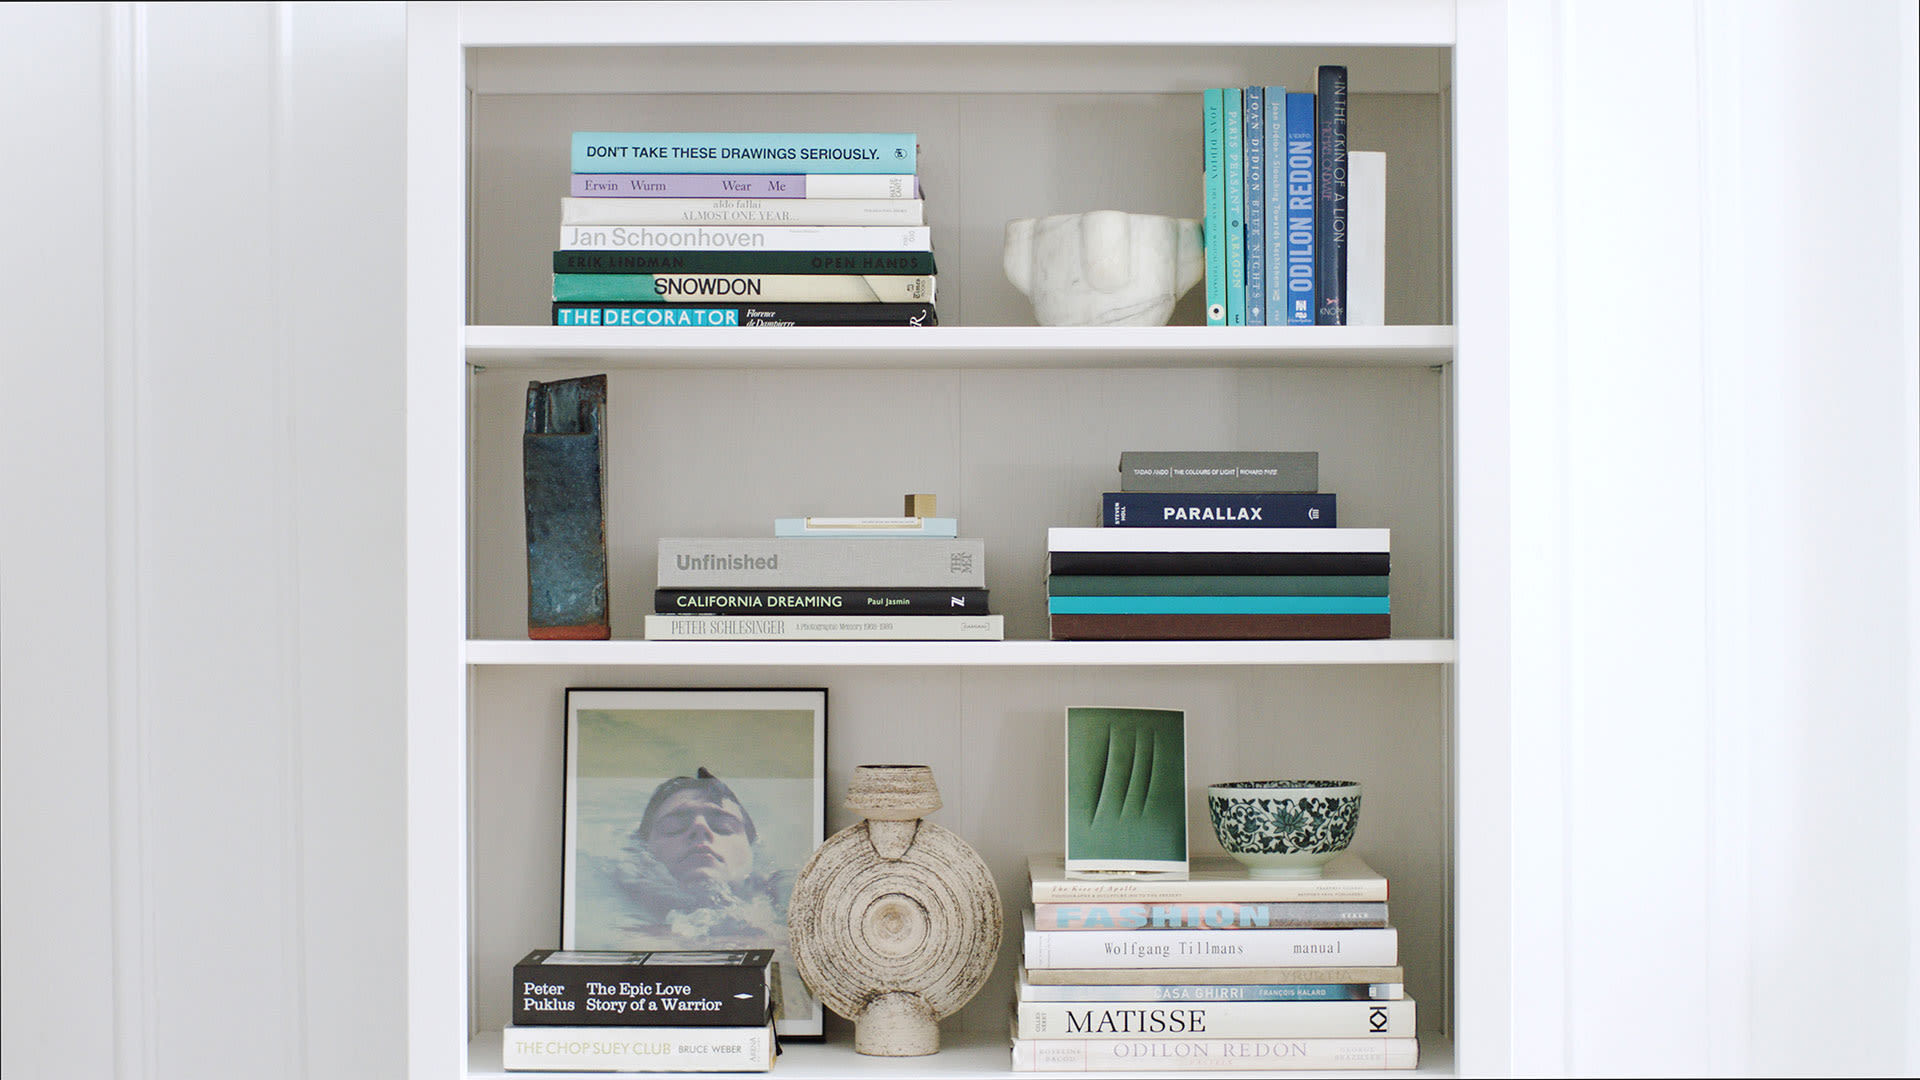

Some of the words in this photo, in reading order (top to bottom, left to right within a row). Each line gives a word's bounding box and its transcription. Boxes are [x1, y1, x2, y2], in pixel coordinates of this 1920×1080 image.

[1334, 81, 1346, 96] IN
[1250, 94, 1260, 130] JOAN
[1272, 102, 1280, 121] Joan
[1334, 100, 1346, 124] THE
[1228, 111, 1238, 148] PARIS
[1272, 124, 1280, 152] Didion
[1333, 125, 1346, 162] SKIN
[586, 146, 628, 158] DON'T
[632, 146, 668, 158] TAKE
[672, 147, 717, 159] THESE
[721, 148, 796, 160] DRAWINGS
[800, 148, 880, 160] SERIOUSLY.
[1251, 139, 1260, 191] DIDION
[1230, 154, 1240, 213] PEASANT
[1272, 160, 1281, 202] Slouching
[1289, 140, 1312, 210] REDON
[1333, 167, 1346, 187] OF
[584, 180, 618, 191] Erwin
[630, 180, 666, 191] Wurm
[722, 180, 752, 192] Wear
[768, 180, 786, 192] Me
[713, 200, 734, 208] aldo
[736, 200, 761, 208] fallai
[1334, 193, 1344, 202] A
[682, 211, 728, 220] ALMOST
[731, 211, 756, 220] ONE
[1252, 200, 1260, 236] BLUE
[570, 228, 606, 246] Jan
[612, 228, 764, 247] Schoonhoven
[568, 256, 602, 268] ERIK
[610, 256, 684, 268] LINDMAN
[811, 257, 855, 268] OPEN
[863, 257, 918, 268] HANDS
[1230, 234, 1242, 288] ARAGON
[1289, 217, 1312, 292] ODILON
[1252, 244, 1261, 298] NIGHTS
[654, 278, 762, 296] SNOWDON
[560, 310, 600, 324] THE
[605, 310, 737, 325] DECORATOR
[746, 308, 776, 318] Florence
[1164, 507, 1263, 521] PARALLAX
[676, 554, 778, 570] Unfinished
[950, 552, 961, 574] THE
[961, 552, 972, 574] MET
[676, 596, 763, 608] CALIFORNIA
[767, 596, 843, 608] DREAMING
[868, 597, 884, 606] Paul
[885, 597, 910, 606] Jasmin
[671, 620, 706, 635] PETER
[710, 620, 785, 635] SCHLESINGER
[1056, 905, 1270, 928] FASHION
[1104, 942, 1170, 958] Wolfgang
[1178, 941, 1244, 955] Tillmans
[1293, 940, 1341, 954] manual
[523, 982, 565, 996] Peter
[586, 982, 616, 996] The
[619, 982, 652, 998] Epic
[655, 982, 692, 996] Love
[1152, 988, 1190, 999] CASA
[1195, 988, 1244, 999] GHIRRI
[523, 998, 576, 1011] Puklus
[586, 998, 625, 1014] Story
[630, 998, 646, 1011] of
[648, 1001, 658, 1011] a
[660, 998, 722, 1012] Warrior
[1065, 1010, 1206, 1034] MATISSE
[516, 1042, 542, 1055] THE
[546, 1042, 589, 1056] CHOP
[592, 1042, 631, 1056] SUEY
[632, 1042, 672, 1056] CLUB
[678, 1044, 708, 1054] BRUCE
[712, 1044, 742, 1054] WEBER
[1114, 1042, 1209, 1058] ODILON
[1224, 1042, 1307, 1057] REDON
